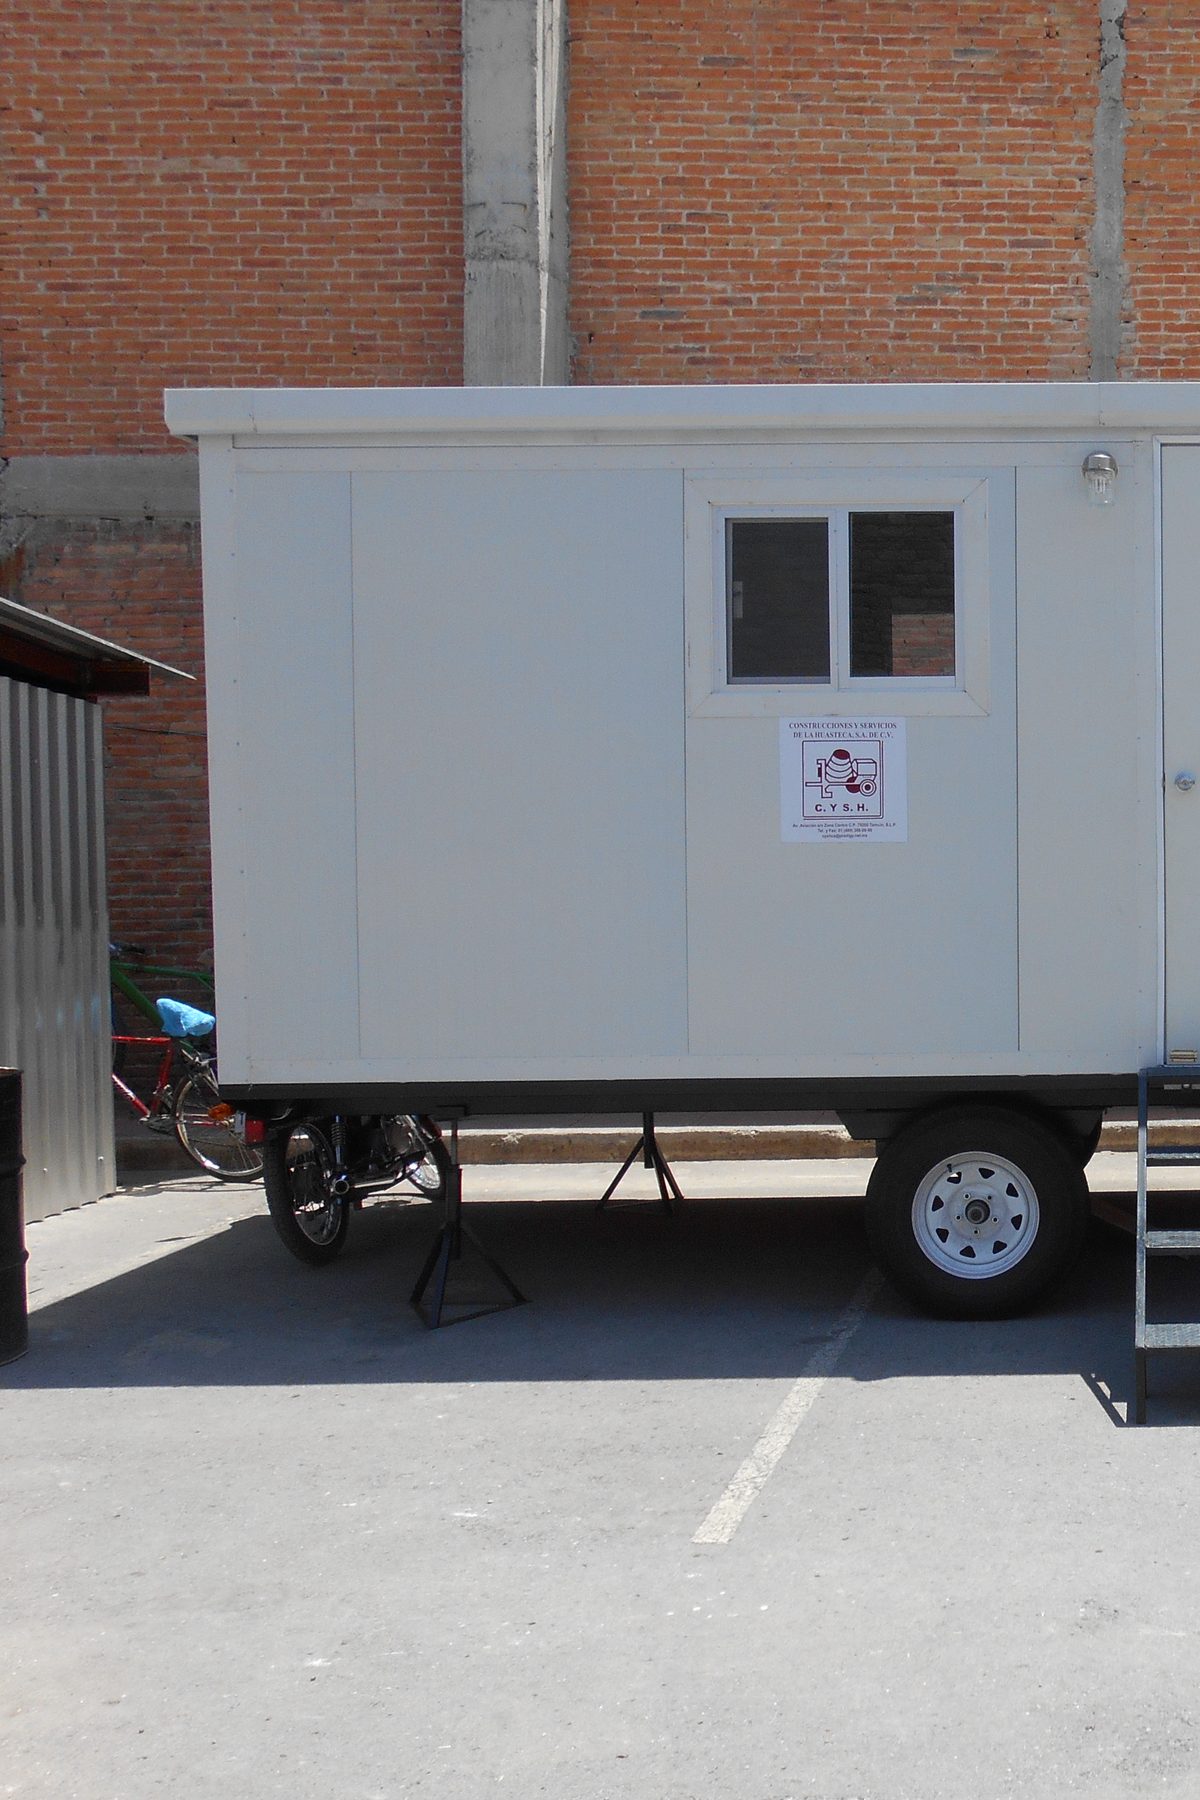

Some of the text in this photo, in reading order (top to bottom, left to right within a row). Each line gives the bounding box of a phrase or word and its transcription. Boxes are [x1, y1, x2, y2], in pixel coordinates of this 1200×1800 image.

[815, 803, 869, 812] C. Y S. H.
